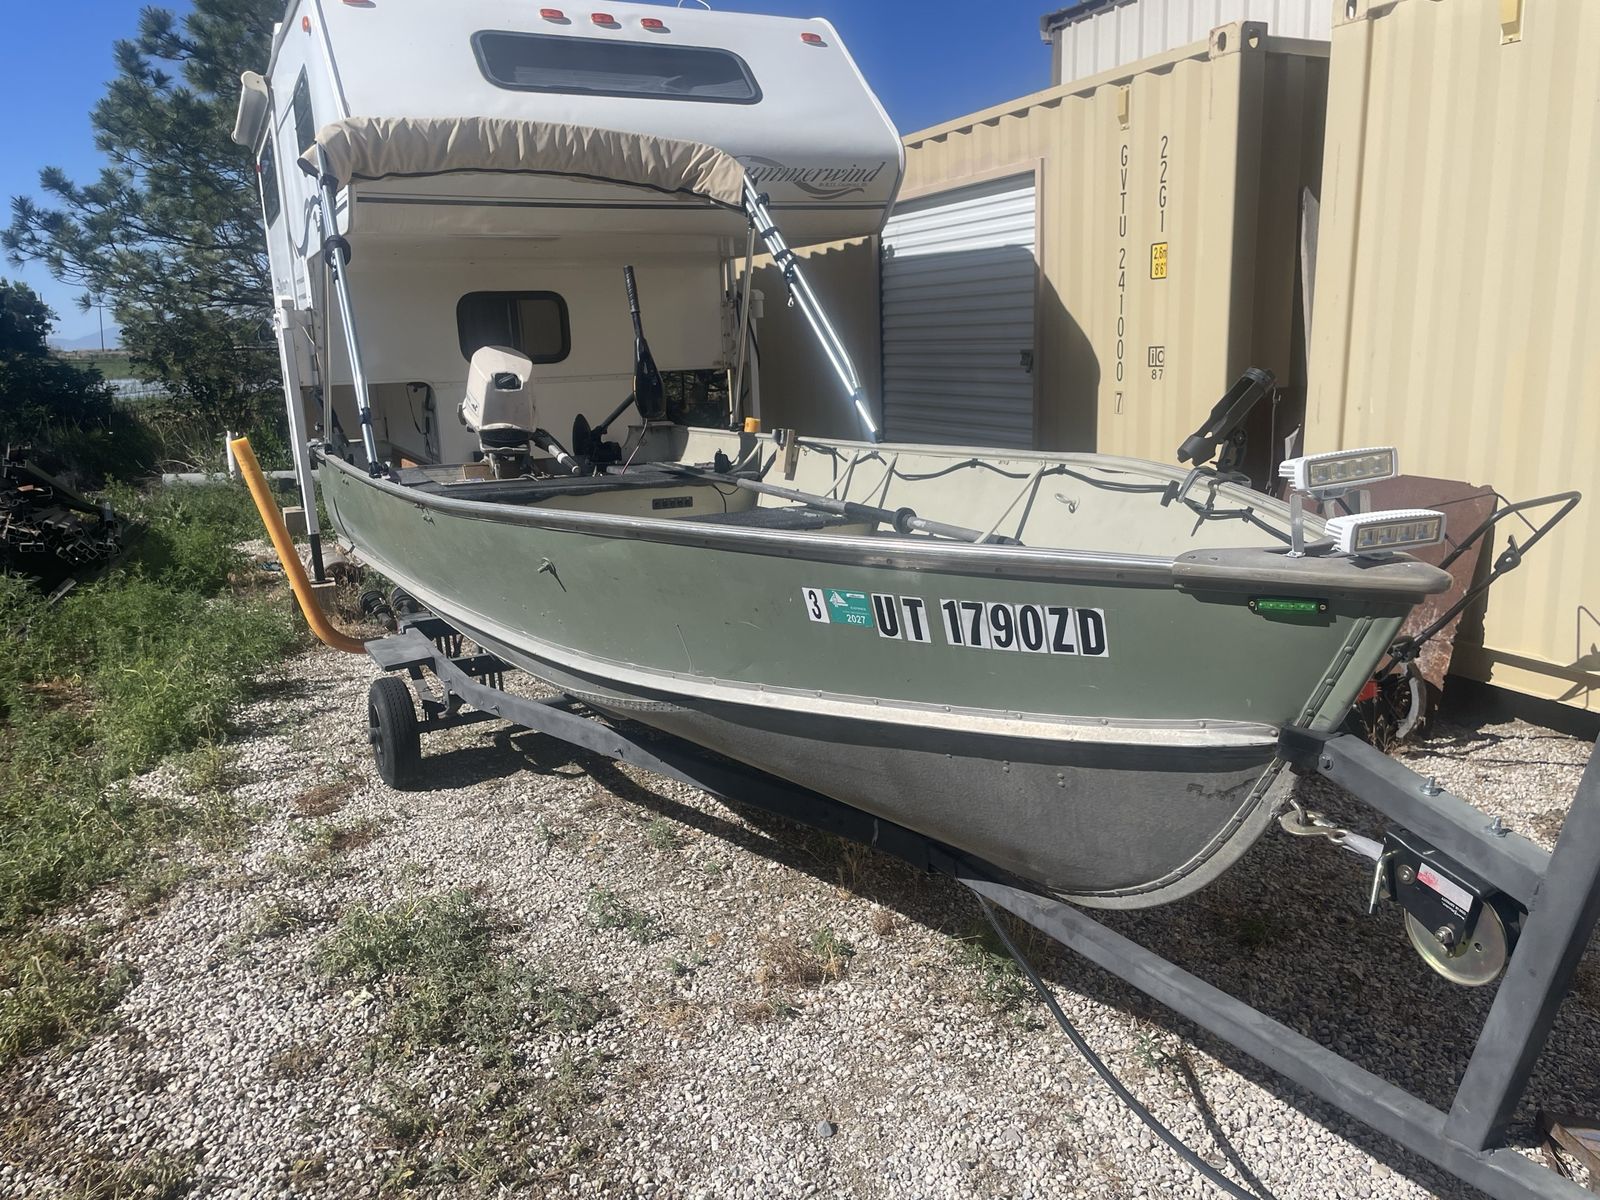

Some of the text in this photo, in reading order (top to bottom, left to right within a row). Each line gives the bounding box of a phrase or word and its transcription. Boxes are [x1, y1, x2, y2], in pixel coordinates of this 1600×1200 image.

[745, 161, 886, 182] ummerwind
[1159, 135, 1169, 233] 22G1
[1115, 144, 1129, 413] GVTU 241000 7
[1151, 368, 1164, 381] 87
[808, 589, 822, 620] 3
[846, 614, 866, 625] 2027
[873, 595, 1106, 656] UT 1790ZD
